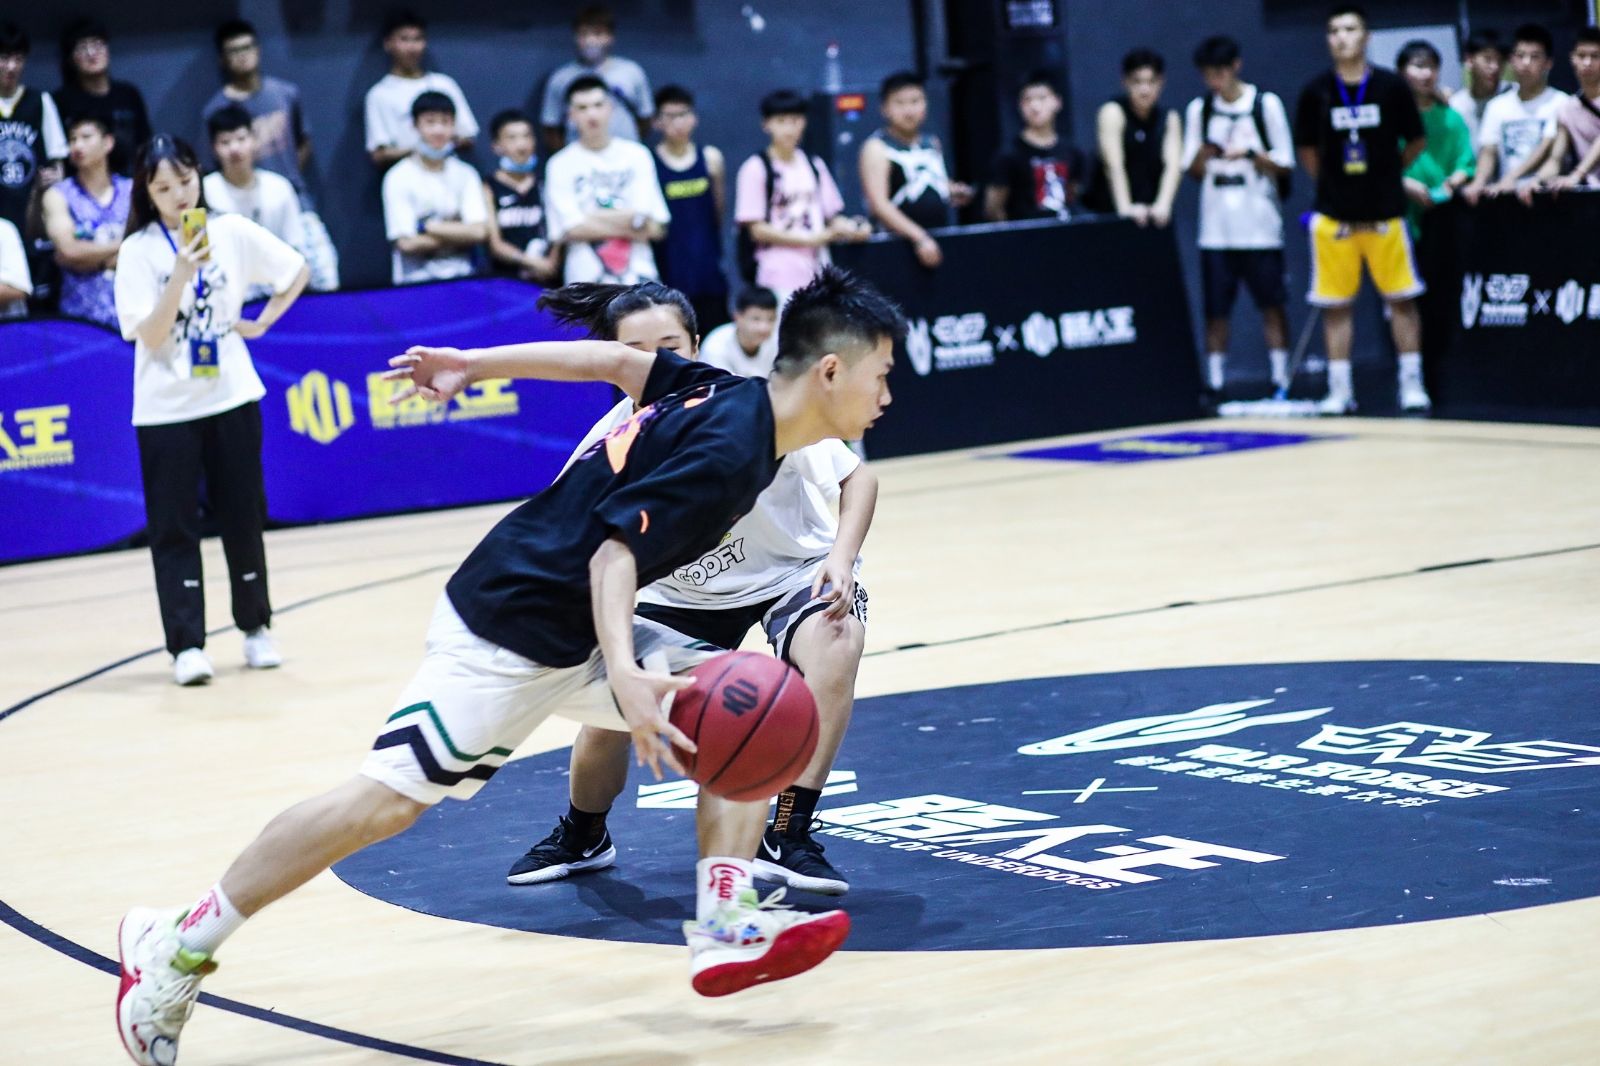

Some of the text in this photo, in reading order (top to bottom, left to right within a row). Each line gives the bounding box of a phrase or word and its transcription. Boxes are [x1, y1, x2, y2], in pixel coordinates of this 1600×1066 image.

[672, 537, 746, 586] GOOFY
[816, 827, 1122, 890] KING OF UNDERDOGS
